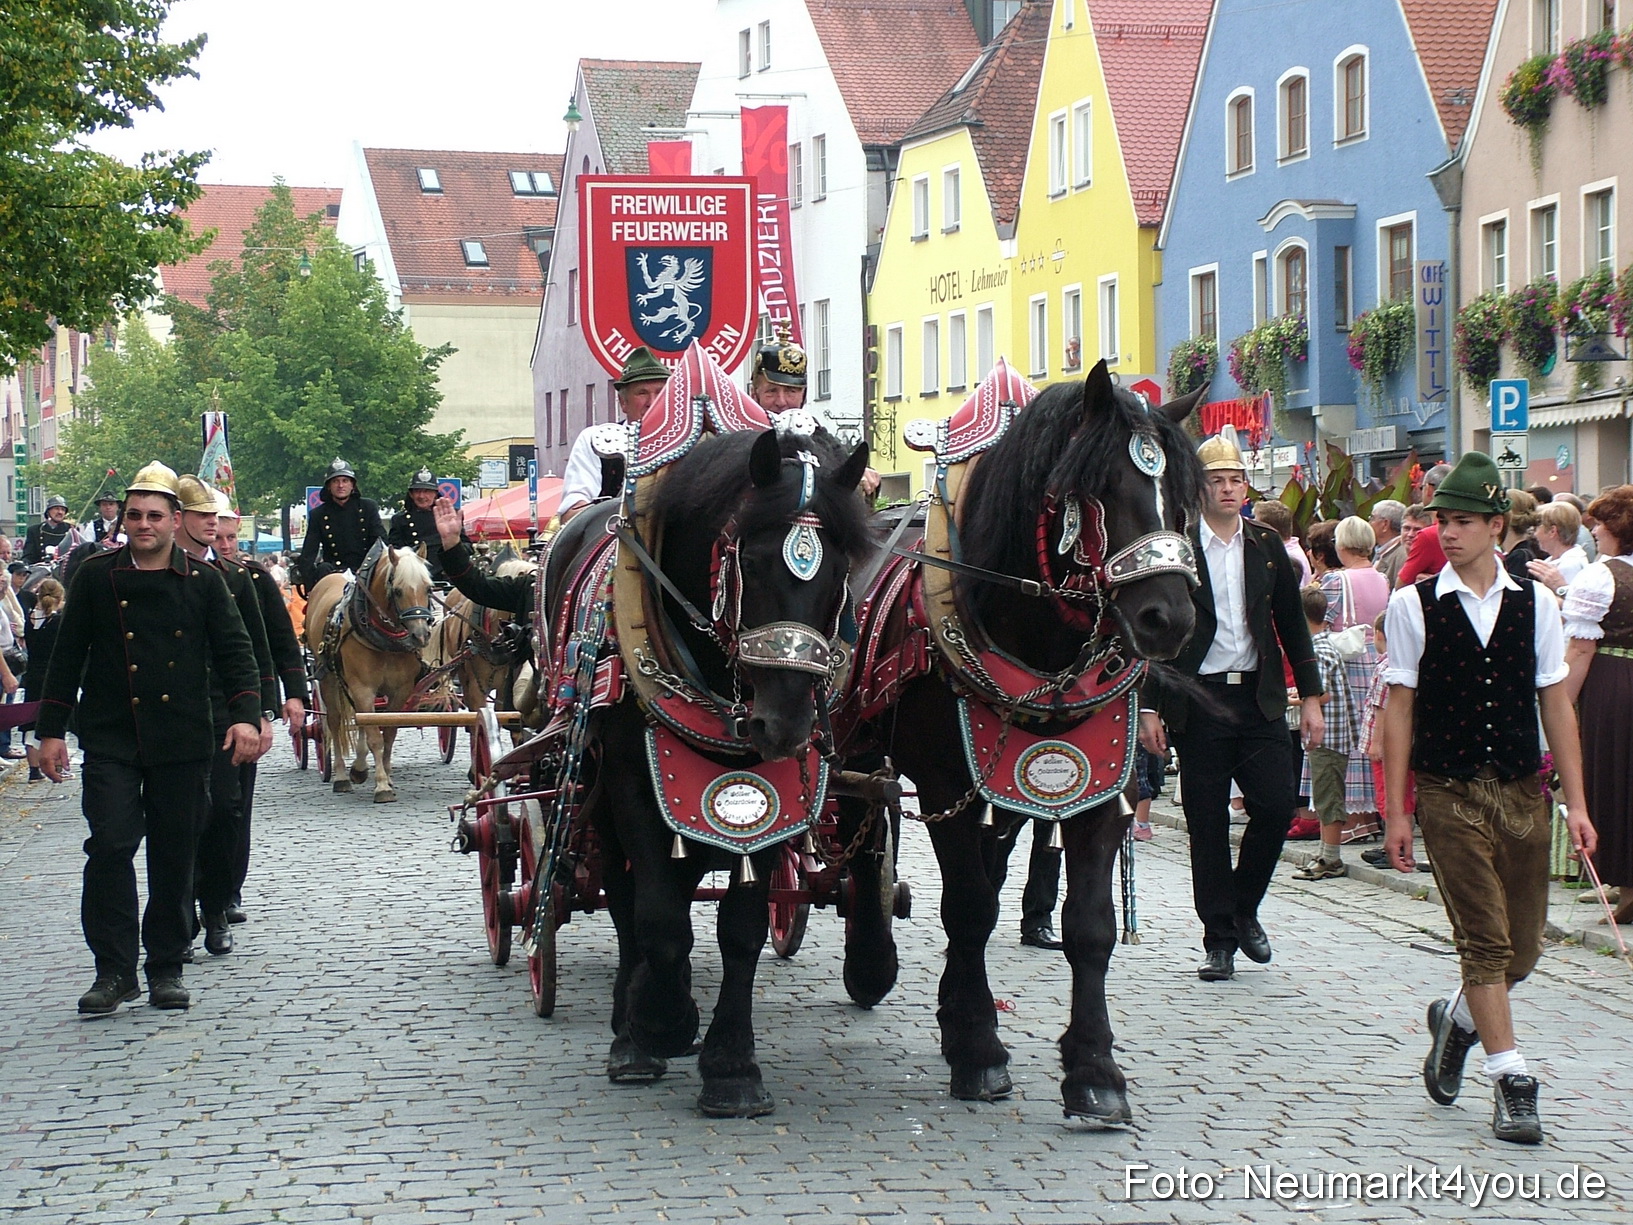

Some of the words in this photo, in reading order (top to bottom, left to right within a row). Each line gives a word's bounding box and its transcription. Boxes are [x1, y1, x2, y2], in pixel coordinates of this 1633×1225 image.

[610, 194, 727, 216] FREIWILLIGE
[611, 221, 728, 241] FEUERWEHR
[1421, 261, 1445, 283] CAFÉ
[930, 271, 962, 305] HOTEL
[971, 264, 1009, 293] Lehmeier
[1423, 287, 1443, 389] WITTL
[1499, 386, 1520, 426] P
[1502, 438, 1515, 446] nur
[530, 465, 536, 488] P
